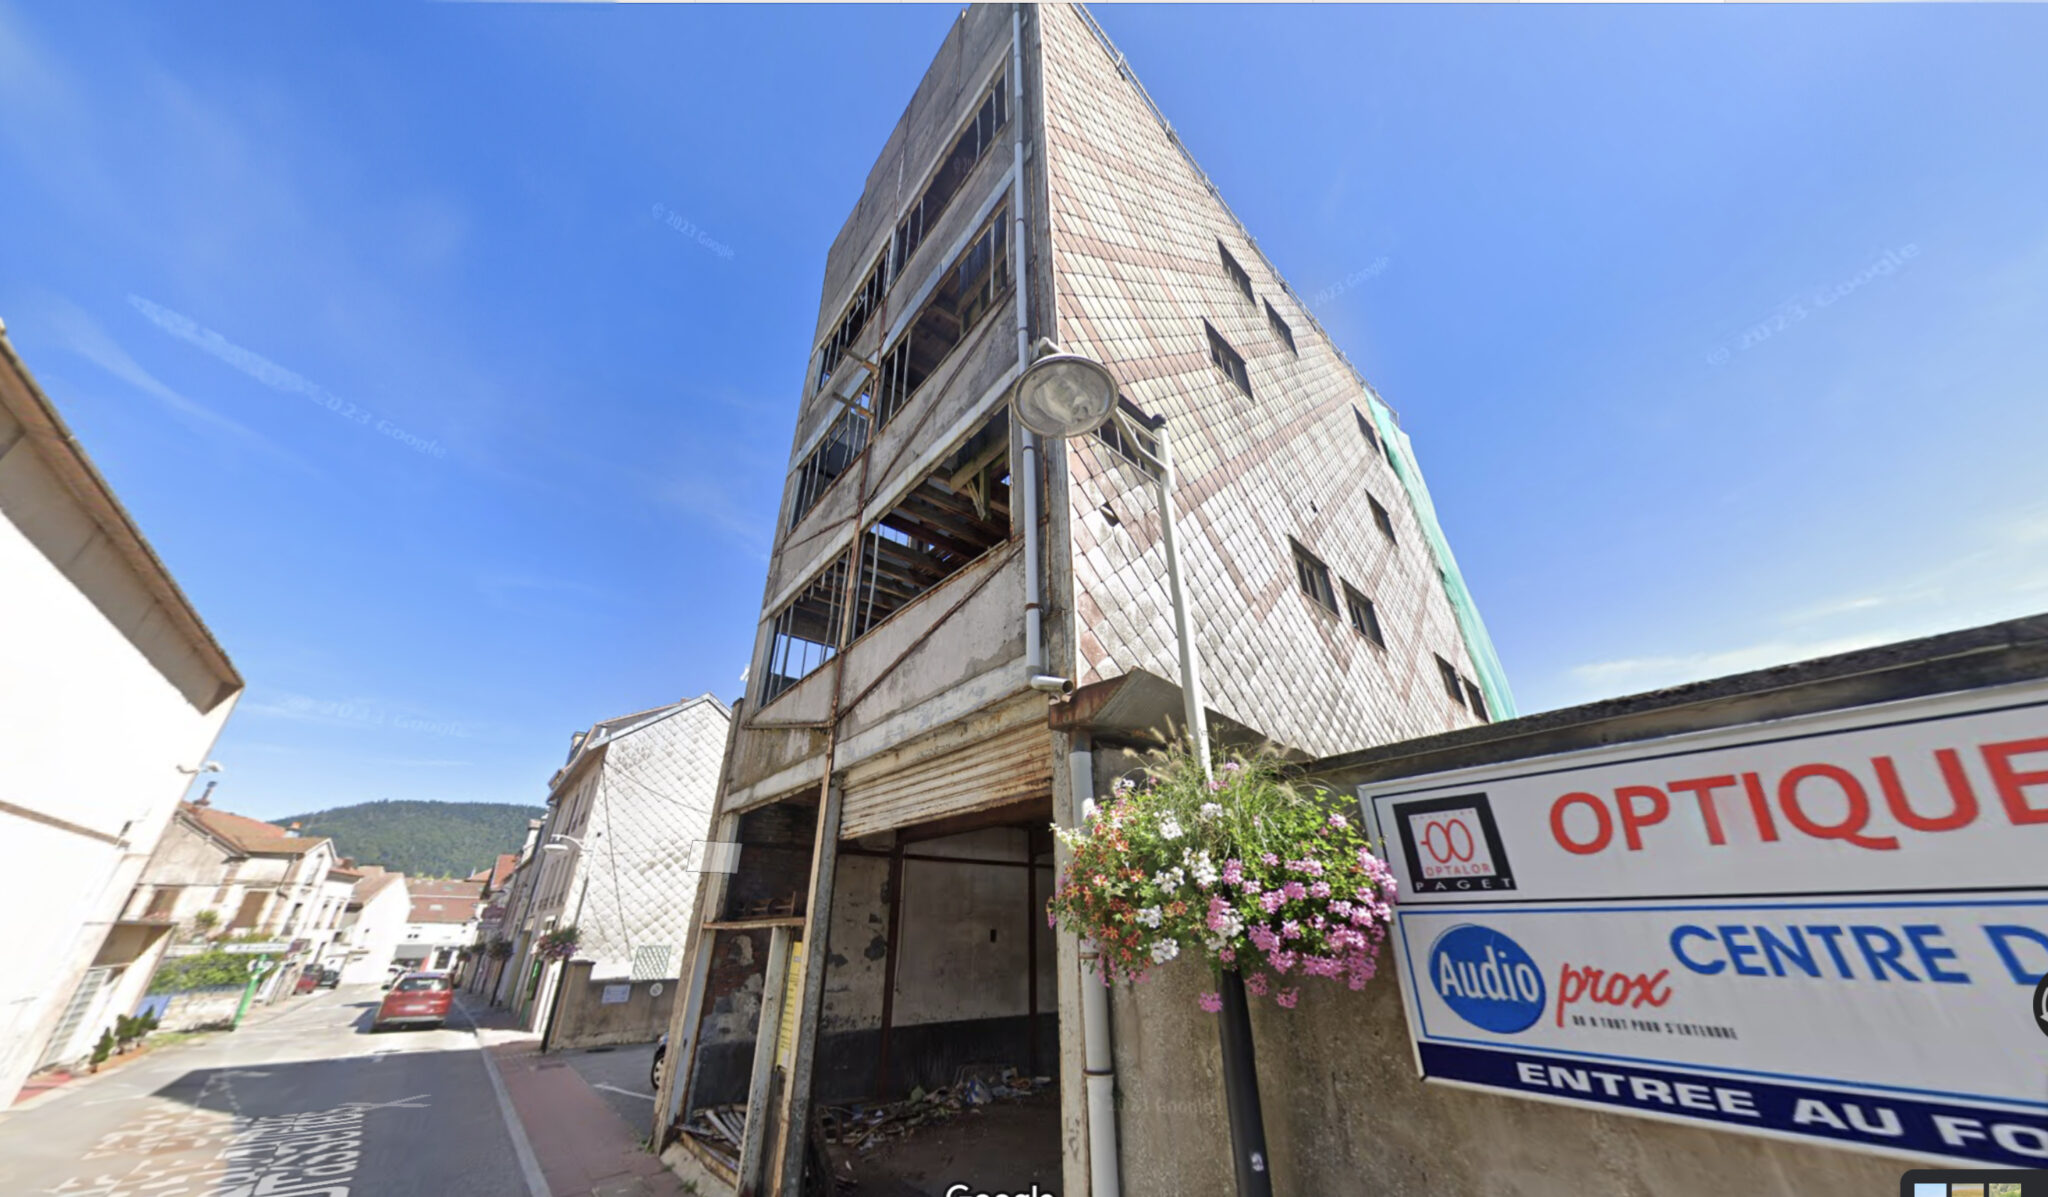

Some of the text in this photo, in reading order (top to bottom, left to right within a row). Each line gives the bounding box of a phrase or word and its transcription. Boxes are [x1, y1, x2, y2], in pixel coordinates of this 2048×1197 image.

[1549, 736, 2048, 856] OPTIQUE
[1415, 878, 1512, 892] PAGET
[1425, 863, 1491, 877] OPTALOR
[1438, 944, 1673, 1029] Audio prox
[1669, 924, 1973, 985] CENTRE
[1516, 1061, 1761, 1118] ENTREE
[1794, 1098, 1904, 1137] AU
